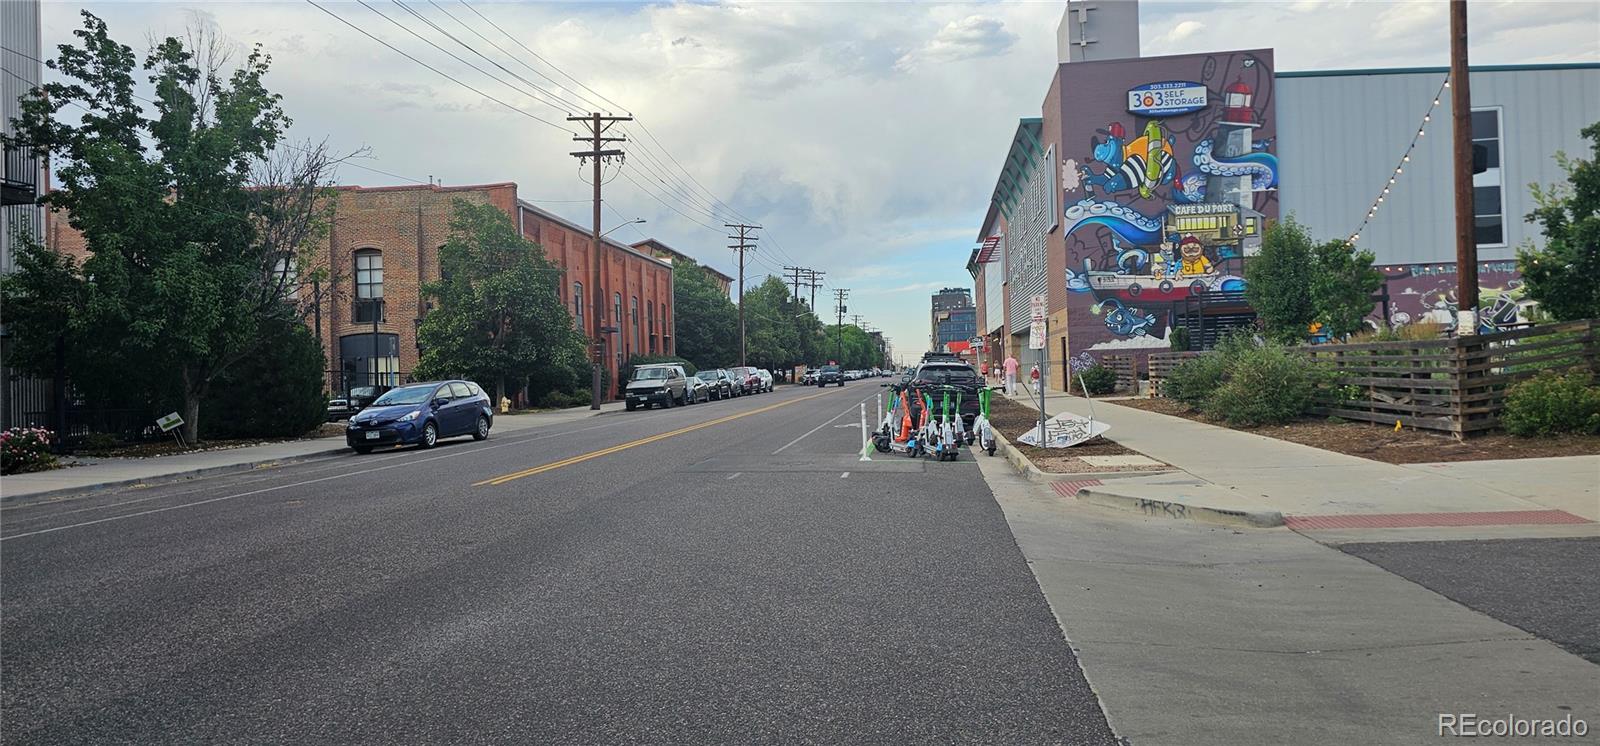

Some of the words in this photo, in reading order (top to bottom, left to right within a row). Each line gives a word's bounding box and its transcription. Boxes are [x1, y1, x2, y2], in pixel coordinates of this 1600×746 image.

[1133, 91, 1163, 107] 303
[1164, 90, 1185, 98] SELF
[1164, 97, 1205, 106] STORAGE
[1175, 206, 1196, 215] CAFE
[1198, 205, 1210, 213] DU
[1212, 204, 1234, 213] PORT
